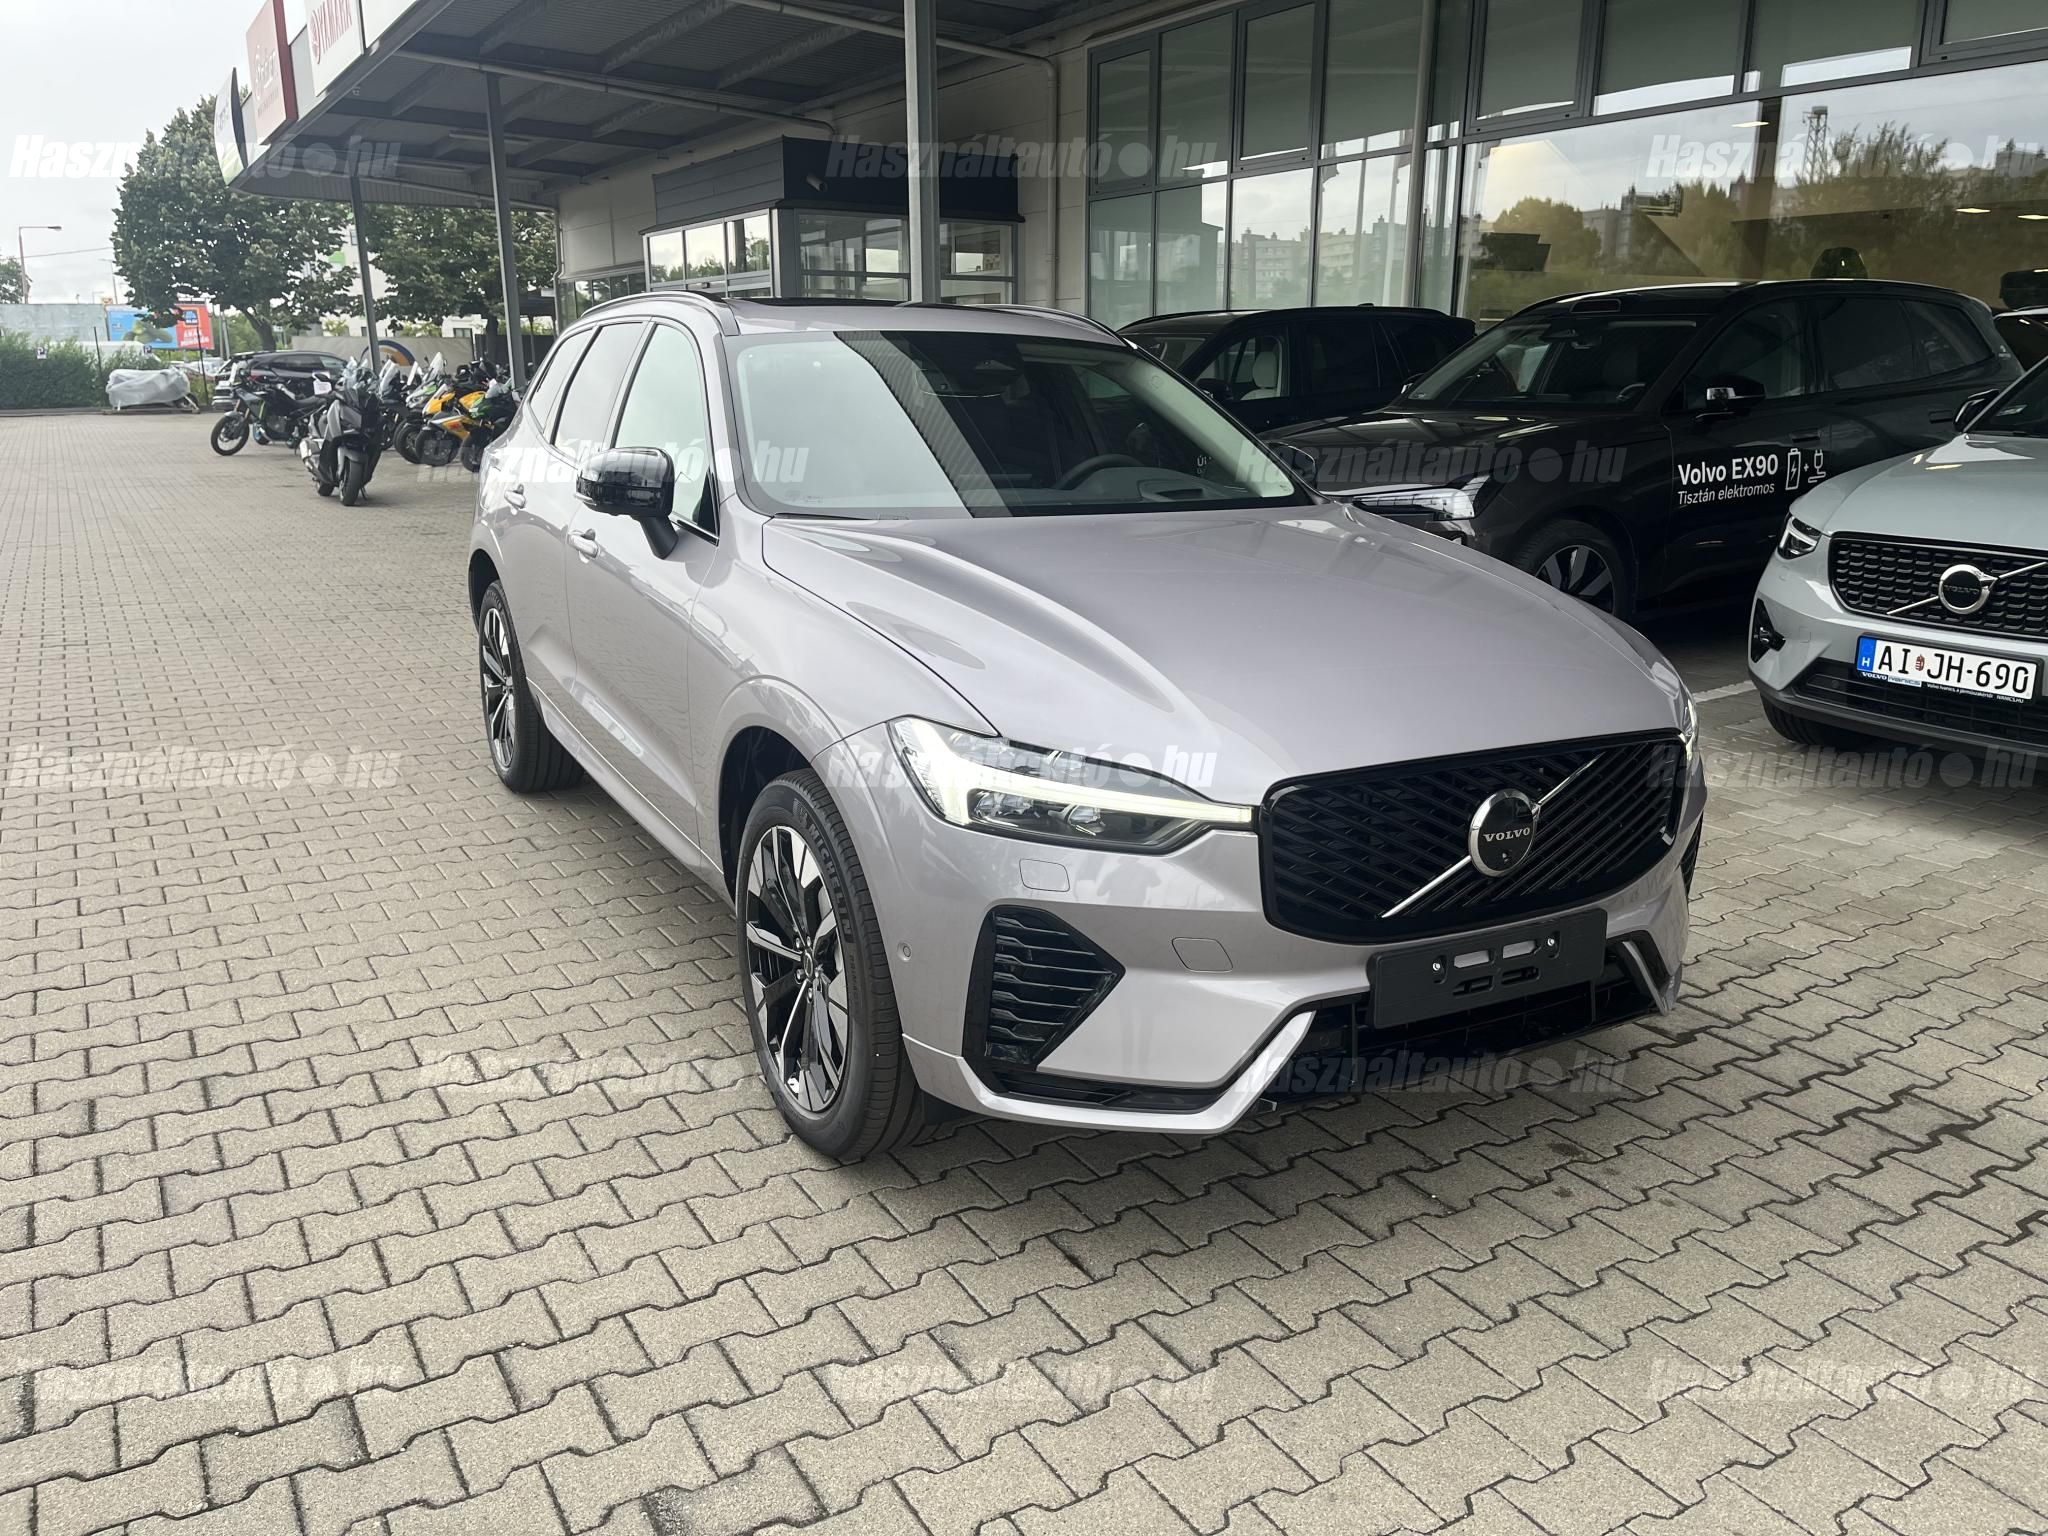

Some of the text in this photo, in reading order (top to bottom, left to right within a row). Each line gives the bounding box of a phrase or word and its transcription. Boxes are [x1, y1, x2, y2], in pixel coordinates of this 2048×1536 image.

[1677, 454, 1779, 485] Volvo EX90
[1677, 482, 1775, 505] Tisztán elektromos
[1861, 671, 1888, 681] VOLVO
[1483, 827, 1531, 842] VOLVO
[807, 823, 853, 937] MICHELIN
